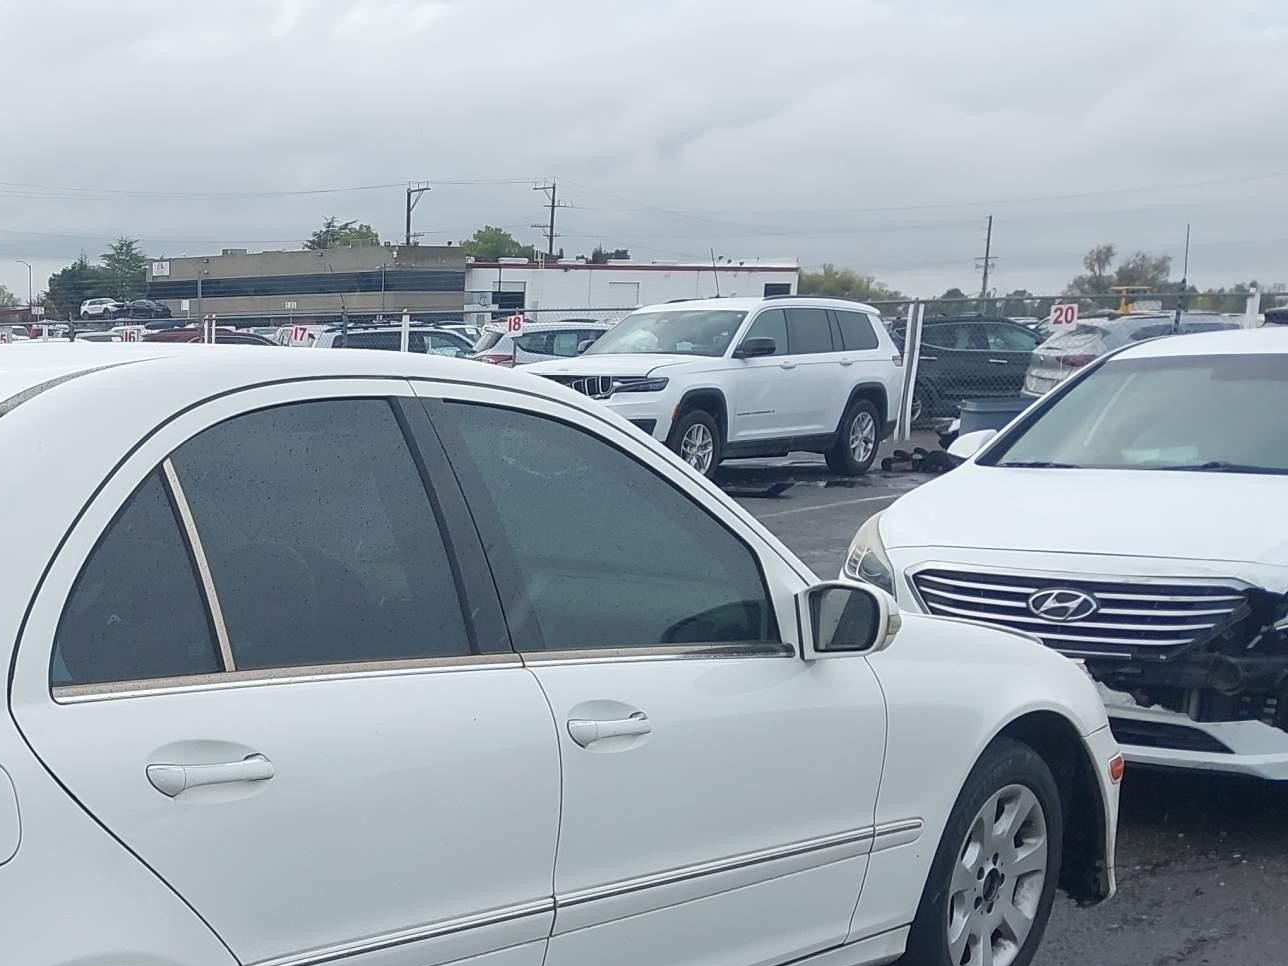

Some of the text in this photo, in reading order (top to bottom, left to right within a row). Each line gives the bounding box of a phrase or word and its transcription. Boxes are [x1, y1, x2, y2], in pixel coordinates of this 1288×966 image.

[1053, 305, 1075, 325] 20
[508, 316, 522, 332] 18
[124, 331, 136, 342] 16
[293, 326, 308, 341] 17
